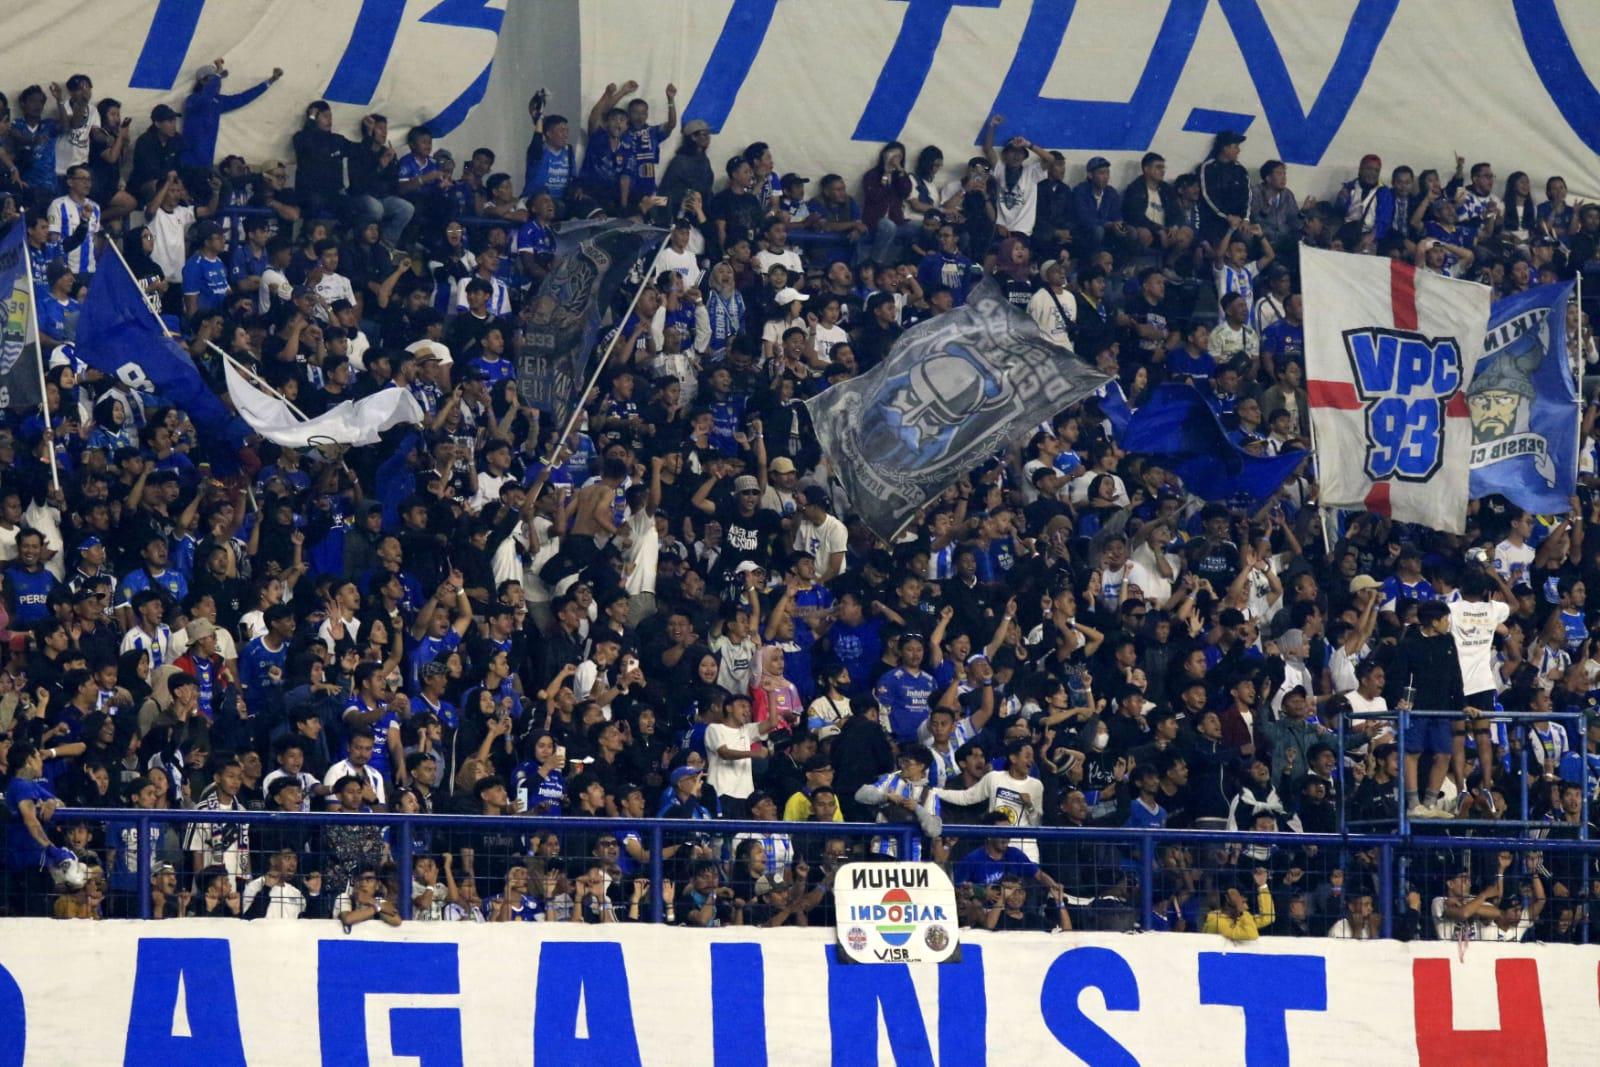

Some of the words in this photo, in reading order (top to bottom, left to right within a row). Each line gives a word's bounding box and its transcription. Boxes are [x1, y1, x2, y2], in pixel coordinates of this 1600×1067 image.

[525, 333, 555, 348] 933
[1349, 332, 1459, 396] VPC
[1369, 397, 1440, 476] 93
[852, 868, 929, 889] NUHUN
[850, 904, 947, 923] INDOSIAR
[124, 936, 1327, 1067] AGAINST
[1413, 957, 1600, 1067] H
